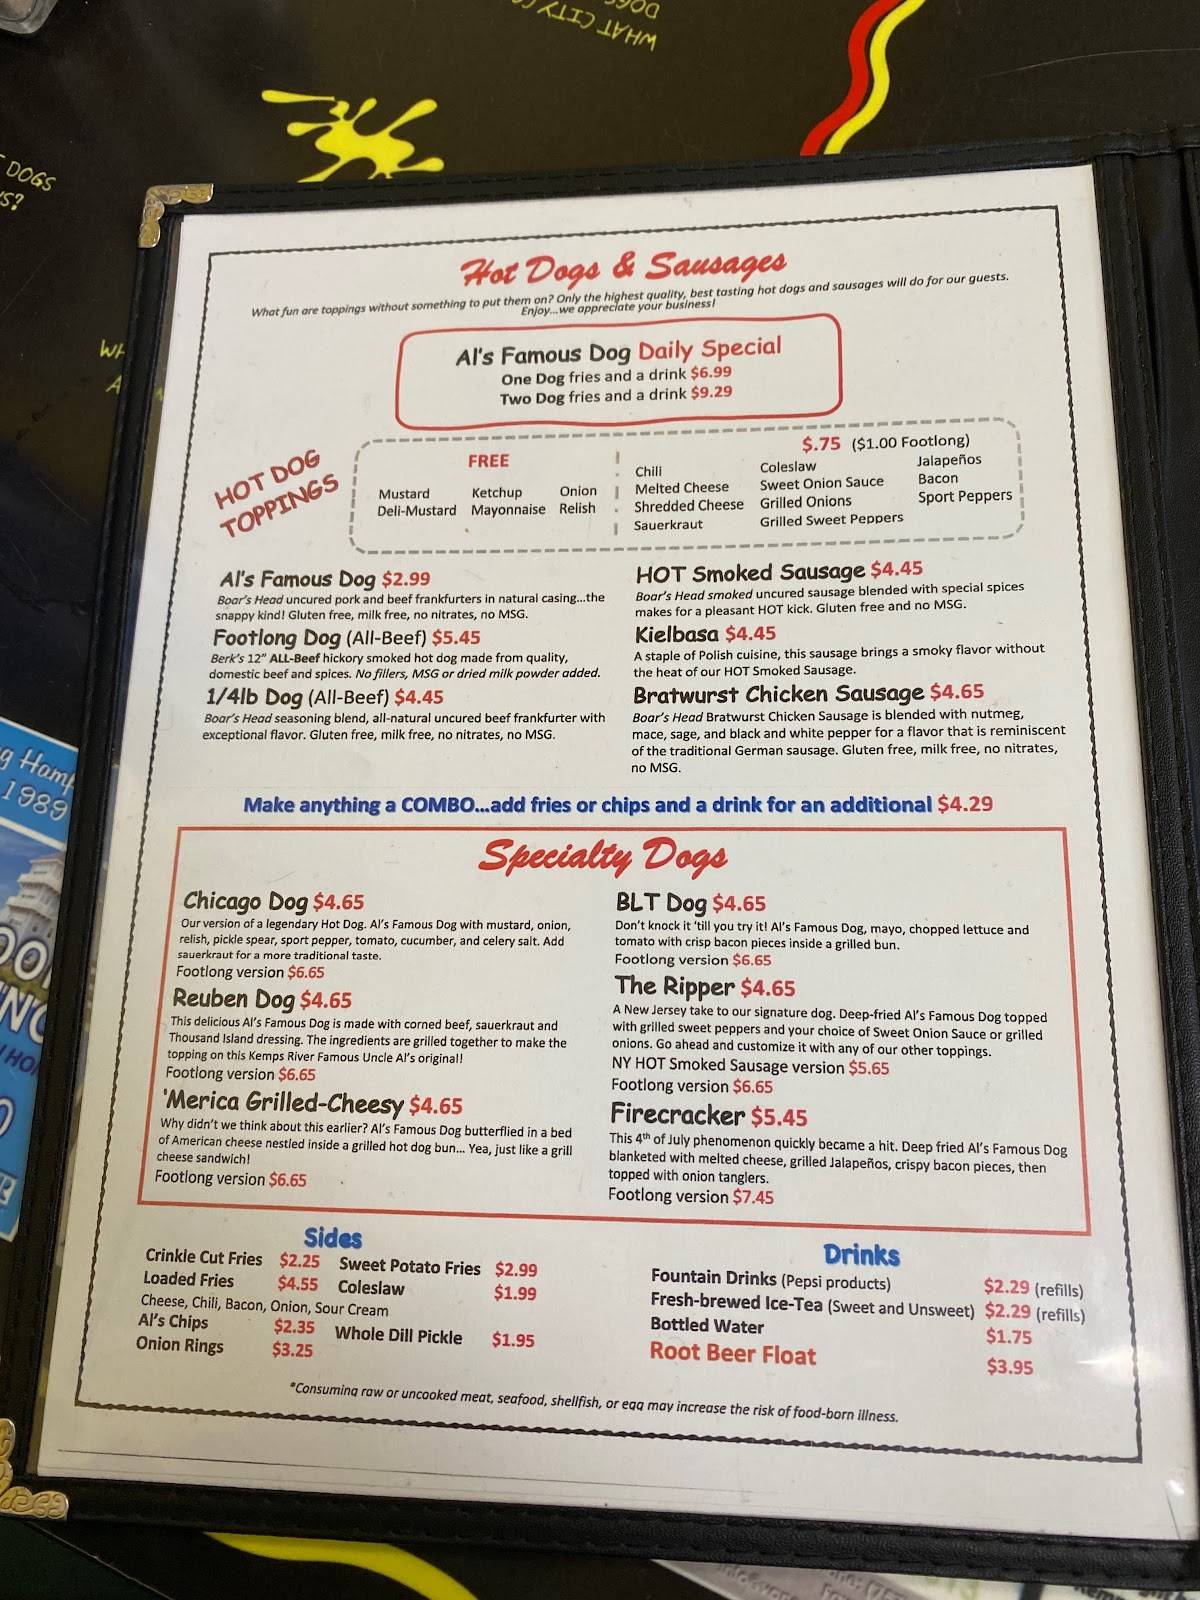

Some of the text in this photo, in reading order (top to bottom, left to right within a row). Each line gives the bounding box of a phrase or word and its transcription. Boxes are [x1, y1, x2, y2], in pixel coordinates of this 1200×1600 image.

[537, 1, 657, 52] WHAT CITY
[6, 160, 57, 191] DOGS
[460, 250, 788, 291] Hot Dogs & Sausages
[455, 335, 781, 367] Al's Famous Dog Daily Special
[501, 365, 732, 387] One Dog fries and a drink $6.99
[802, 433, 970, 454] $.75 ($1.00 Footlong)
[468, 453, 510, 468] FREE
[635, 465, 662, 478] Chili
[760, 460, 817, 474] Coleslaw
[917, 454, 982, 469] Jalapeños
[214, 449, 321, 510] HOT DOG
[635, 482, 730, 495] Melted Cheese
[760, 476, 885, 491] Sweet Onion Sauce
[918, 473, 959, 485] Bacon
[379, 488, 430, 500] Mustard
[472, 487, 523, 501] Ketchup
[560, 485, 597, 497] Onion
[918, 490, 1013, 506] Sport Peppers
[219, 473, 339, 538] TOPPINGS
[377, 504, 457, 517] Deli-Mustard
[471, 503, 546, 519] Mayonnaise
[559, 501, 596, 515] Relish
[634, 499, 745, 513] Shredded Cheese
[760, 495, 852, 510] Grilled Onions
[634, 519, 704, 531] Sauerkraut
[760, 513, 904, 528] Grilled Sweet Peppers
[219, 569, 431, 592] Al's Famous Dog $2.99
[636, 560, 923, 584] HOT Smoked Sausage $4.45
[213, 628, 481, 651] Footlong Dog (All-Beef) $5.45
[635, 624, 777, 644] Kielbasa $4.45
[206, 687, 444, 711] 1/4lb Dog (All-Beef) $4.45
[633, 682, 985, 707] Bratwurst Chicken Sausage $4.65
[631, 762, 682, 773] no MSG.
[2, 781, 68, 821] 1989
[244, 794, 993, 817] Make anything a COMBO...add fries or chips and a drink for an additional $4.29
[478, 836, 729, 881] Specialty Dogs
[183, 890, 365, 917] Chicago Dog $4.65
[616, 891, 767, 918] BLT Dog $4.65
[176, 964, 325, 981] Footlong version $6.65
[614, 974, 796, 1002] The Ripper $4.65
[173, 987, 352, 1015] Reuben Dog $4.65
[163, 1088, 463, 1121] 'Merica Grilled-Cheesy $4.65
[611, 1101, 808, 1128] Firecracker $5.45
[156, 1151, 250, 1165] cheese sandwich!
[608, 1168, 769, 1186] topped with onion tanglers.
[304, 1226, 363, 1250] Sides
[146, 1248, 320, 1269] Crinkle Cut Fries $2.25
[823, 1243, 901, 1268] Drinks
[339, 1256, 538, 1278] Sweet Potato Fries $2.99
[143, 1270, 319, 1292] Loaded Fries $4.55
[338, 1279, 537, 1302] Coleslaw $1.99
[652, 1268, 1084, 1301] Fountain Drinks (Pepsi products) $2.29 (refills)
[138, 1313, 315, 1335] Al's Chips $2.35
[651, 1316, 1032, 1345] Bottled Water $1.75
[650, 1340, 1034, 1376] Root Beer Float $3.95
